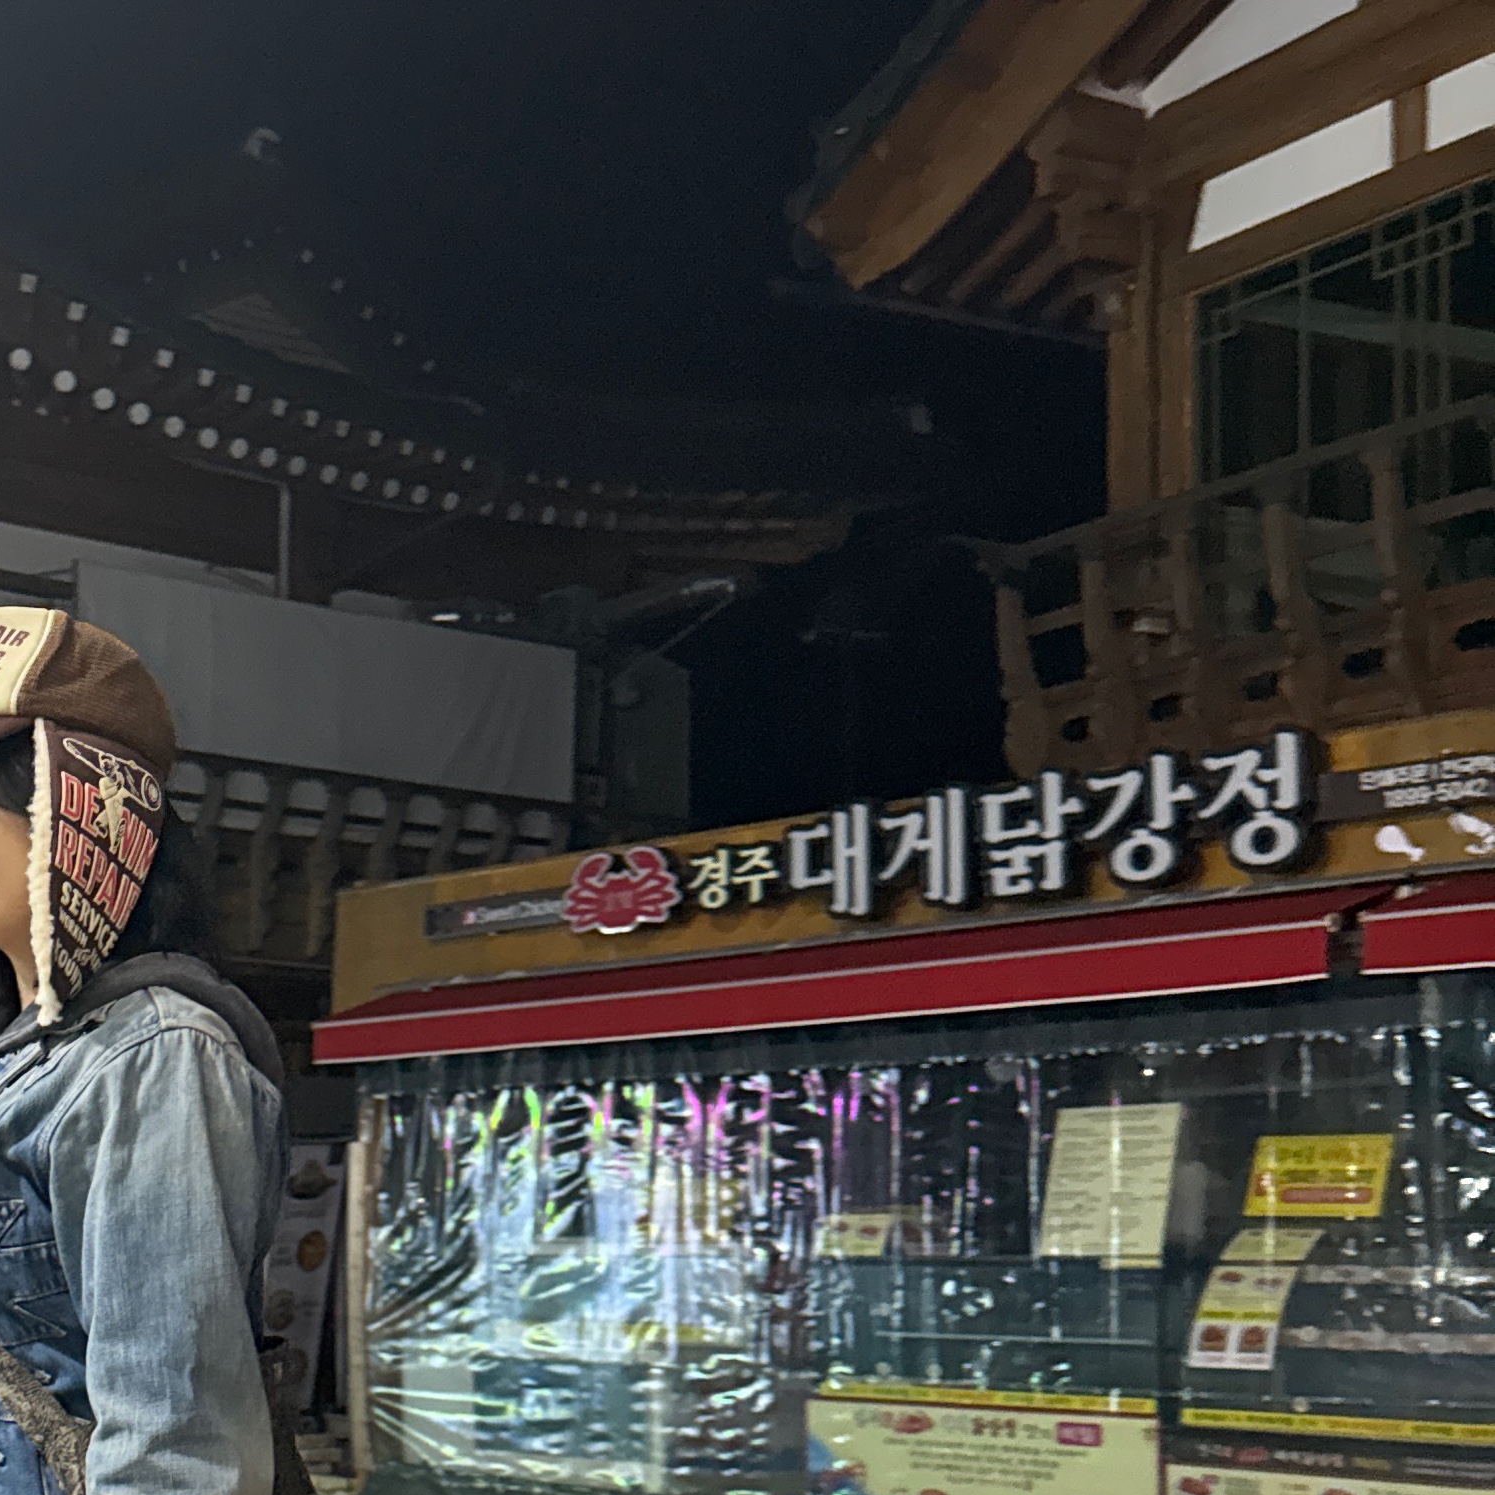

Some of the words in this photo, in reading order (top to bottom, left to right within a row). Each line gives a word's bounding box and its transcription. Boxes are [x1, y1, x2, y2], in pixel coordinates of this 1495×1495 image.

[55, 820, 141, 931] REPAIR
[689, 845, 780, 909] 경주
[789, 732, 1299, 915] 대게닭강정
[61, 881, 118, 957] SERVICE
